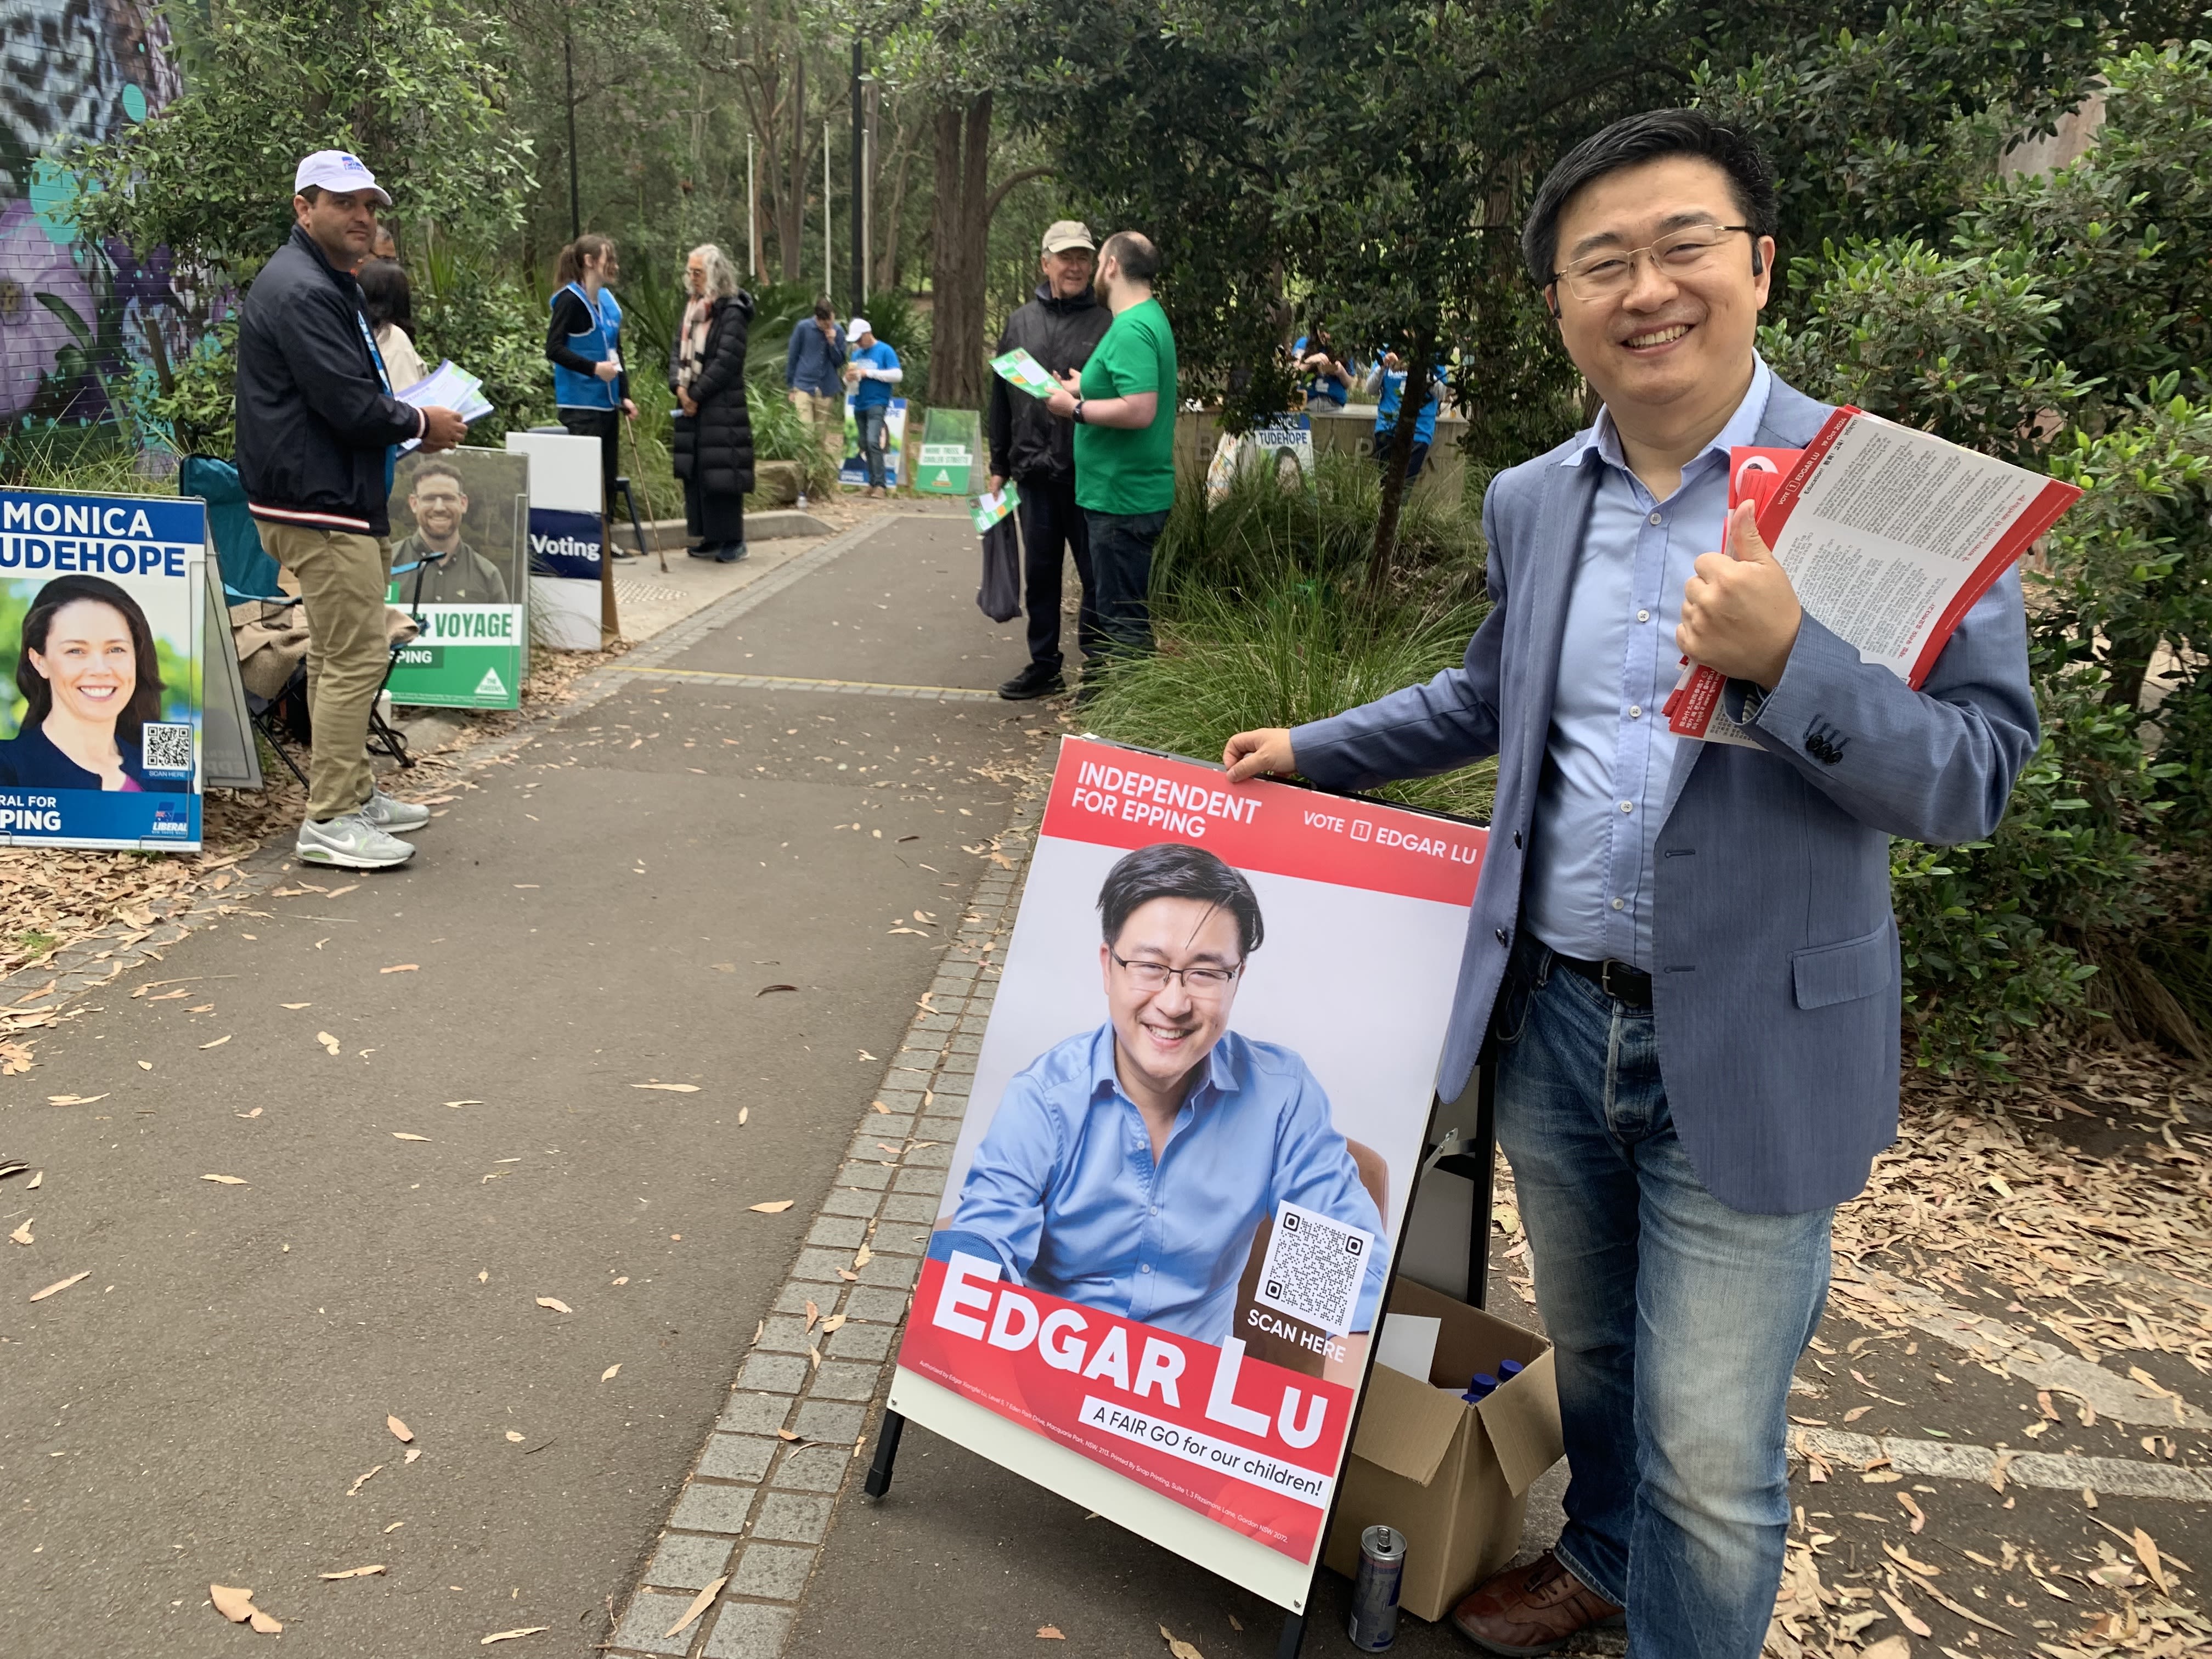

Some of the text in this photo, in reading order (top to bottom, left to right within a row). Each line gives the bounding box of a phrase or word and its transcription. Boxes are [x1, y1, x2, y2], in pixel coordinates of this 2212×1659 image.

[1259, 432, 1307, 445] TUDEHOPE
[1778, 492, 1790, 505] VOTE
[1795, 460, 1814, 481] EDGAR
[1811, 452, 1820, 462] LU
[1826, 430, 1837, 440] Oct
[1833, 417, 1847, 431] 2024
[1804, 468, 1824, 494] Education!
[3, 501, 154, 538] MONICA
[530, 534, 601, 562] Voting
[435, 613, 512, 637] VOYAGE
[388, 650, 433, 664] PING
[28, 795, 57, 808] FOR
[1071, 787, 1206, 838] FOR EPPING
[1077, 761, 1262, 824] INDEPENDENT
[152, 822, 188, 831] LIBERAL
[1304, 810, 1345, 833] VOTE
[1375, 827, 1447, 857] EDGAR
[1451, 844, 1477, 864] LU
[933, 1250, 1186, 1408] EDGAR
[1247, 1309, 1346, 1363] SCAN HERE
[919, 1360, 943, 1375] Authorised
[949, 1374, 962, 1384] Edgar
[988, 1393, 1001, 1403] Level
[1009, 1403, 1021, 1413] Eden
[1022, 1409, 1032, 1418] Park
[1032, 1414, 1046, 1426] Drive,
[1046, 1422, 1072, 1438] Macquarie
[1072, 1434, 1084, 1445] Park,
[1085, 1441, 1098, 1452] NSW,
[1098, 1447, 1109, 1457] 2113.
[1110, 1453, 1129, 1466] Printed
[1136, 1465, 1149, 1476] Snap
[1150, 1472, 1170, 1487] Printing,
[1171, 1482, 1184, 1493] Suite
[1194, 1493, 1221, 1511] Fitzsimons
[1222, 1506, 1236, 1519] Lane,
[1237, 1514, 1259, 1528] Gordon
[1259, 1525, 1273, 1535] NSW
[1273, 1531, 1288, 1543] 2072.
[1093, 1407, 1323, 1497] A FAIR GO for our children!
